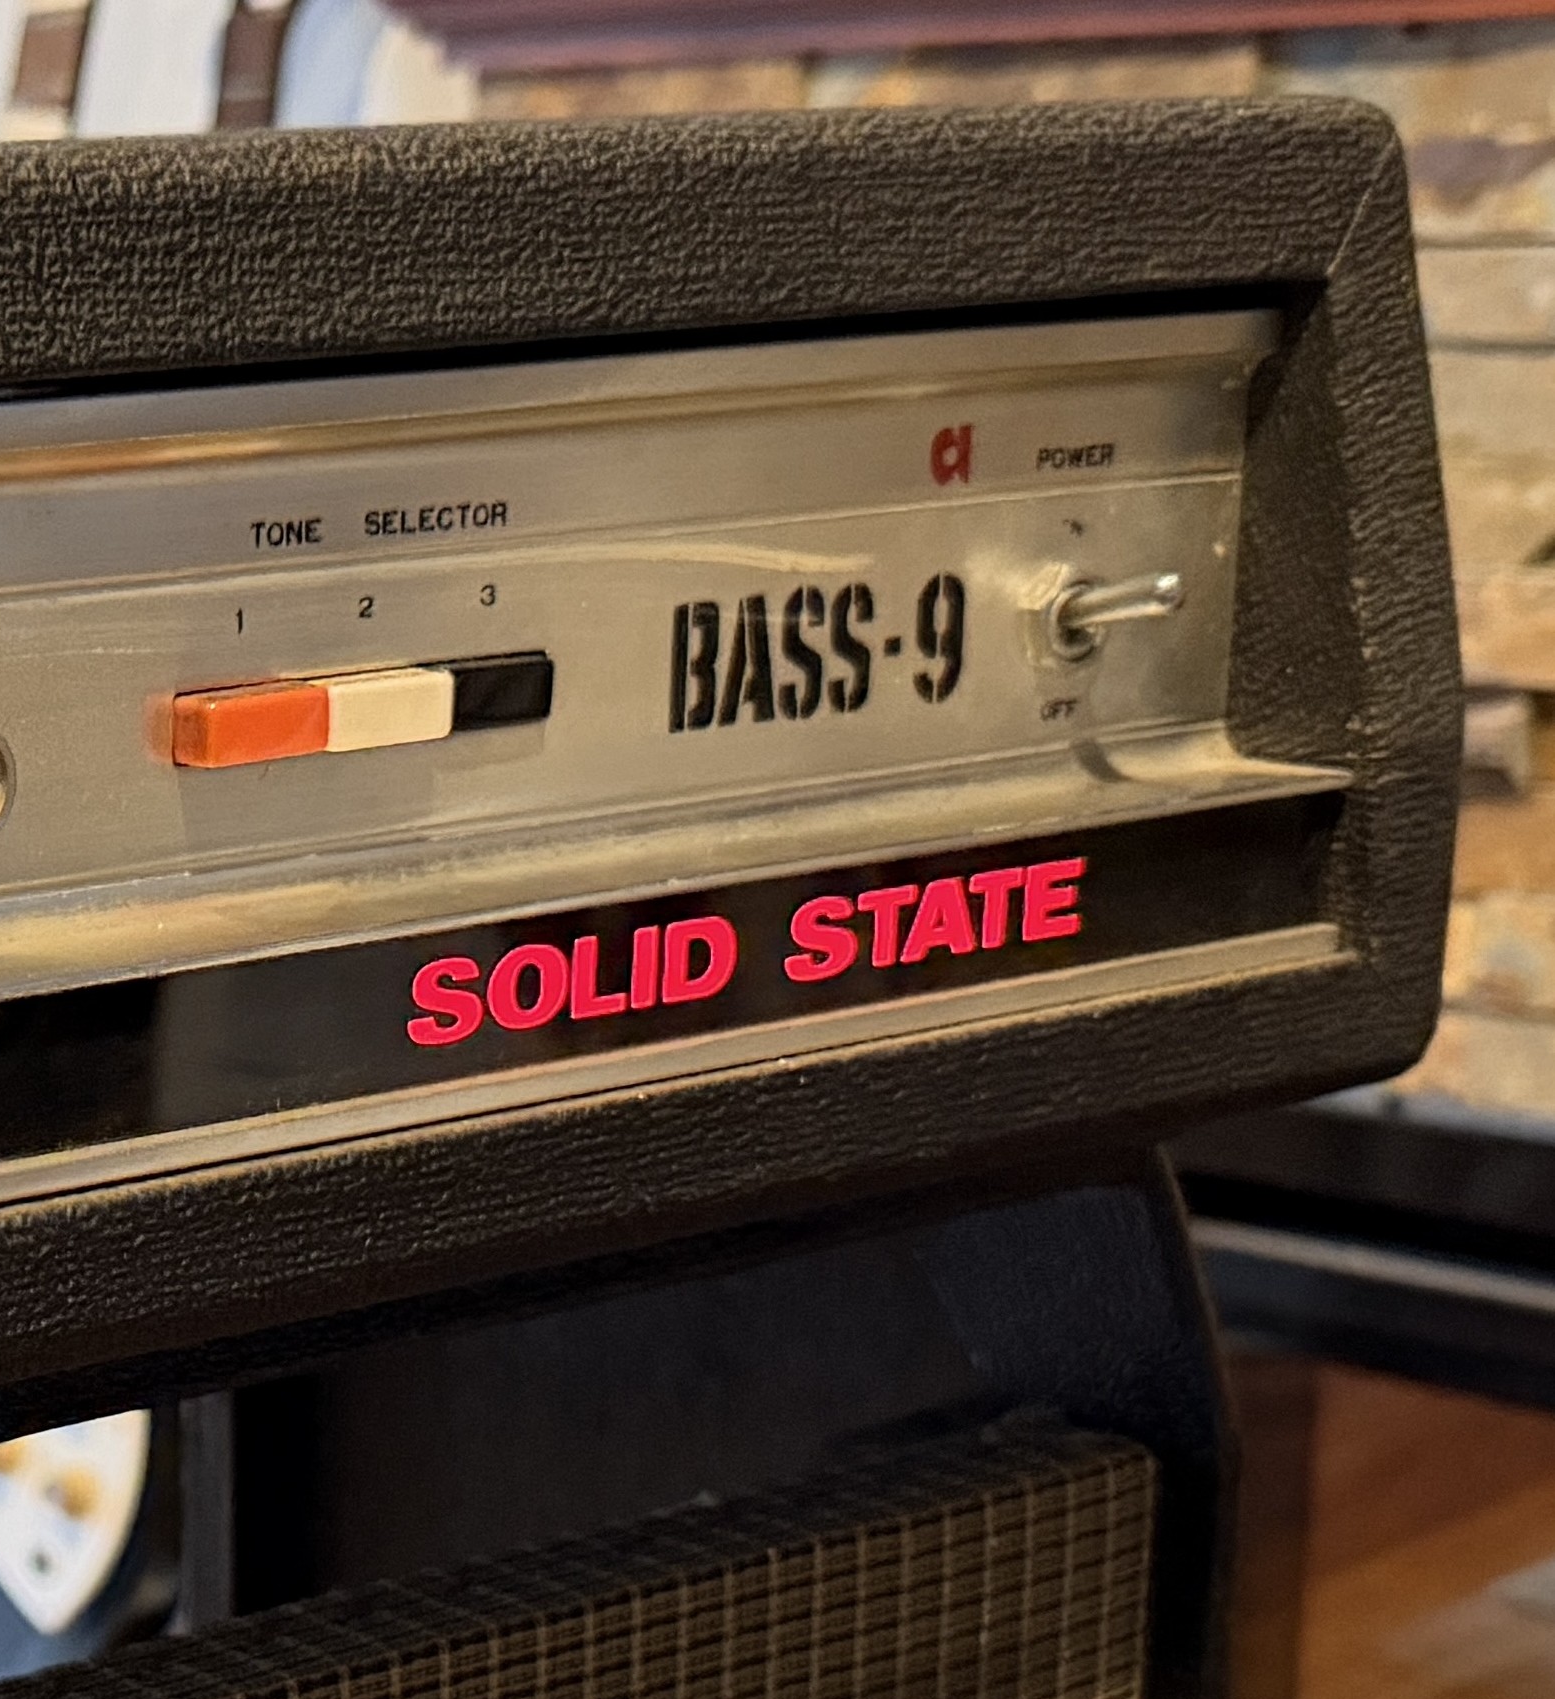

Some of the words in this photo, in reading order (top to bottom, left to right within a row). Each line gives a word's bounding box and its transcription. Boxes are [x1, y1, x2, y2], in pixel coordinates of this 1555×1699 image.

[1036, 443, 1115, 470] POWER
[250, 517, 323, 548] TONE
[364, 500, 508, 536] SELECTOR
[235, 607, 244, 635] 1
[357, 596, 375, 619] 2
[479, 584, 497, 607] 3
[668, 572, 966, 734] BASS-9
[406, 917, 738, 1048] SOLID
[784, 857, 1087, 984] STATE
